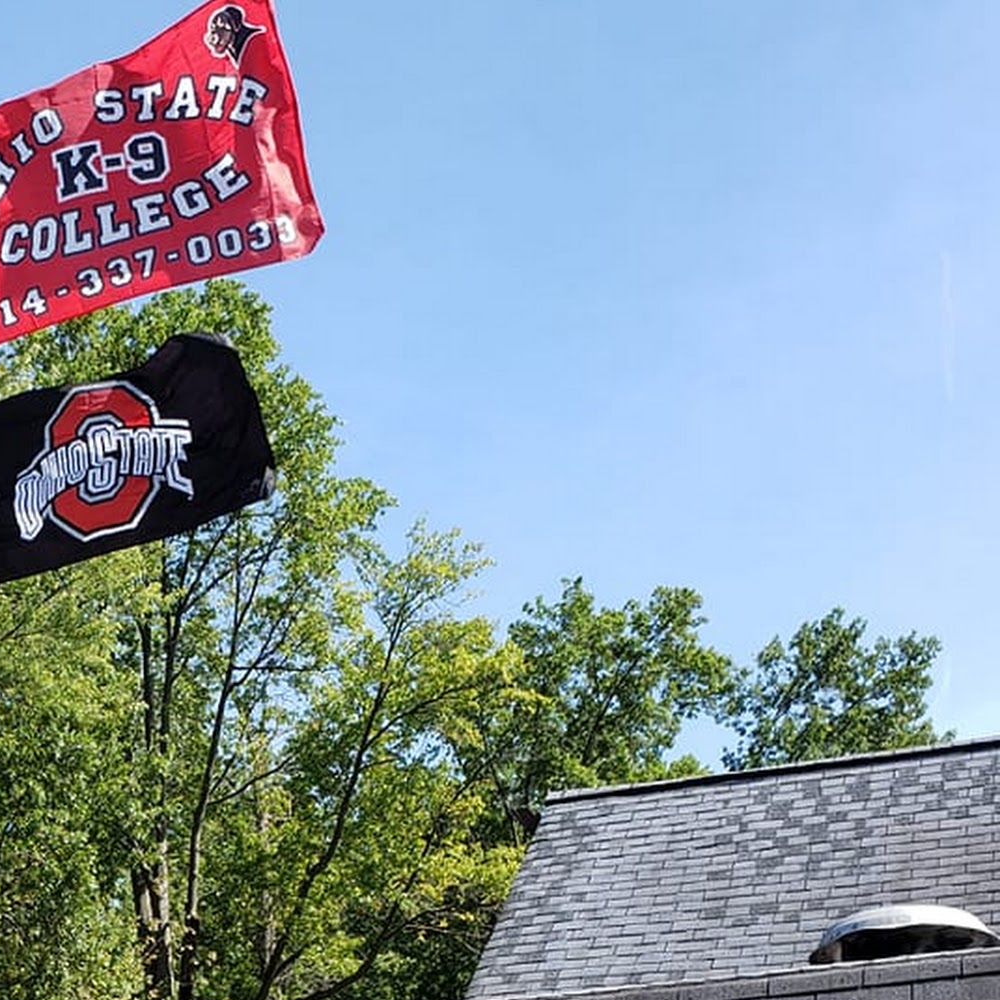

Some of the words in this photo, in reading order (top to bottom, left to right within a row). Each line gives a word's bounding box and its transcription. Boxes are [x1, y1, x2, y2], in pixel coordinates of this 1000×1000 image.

[94, 74, 267, 126] STATE
[51, 131, 171, 203] K-9
[0, 152, 251, 265] COLLEGE
[86, 422, 194, 500] STATE
